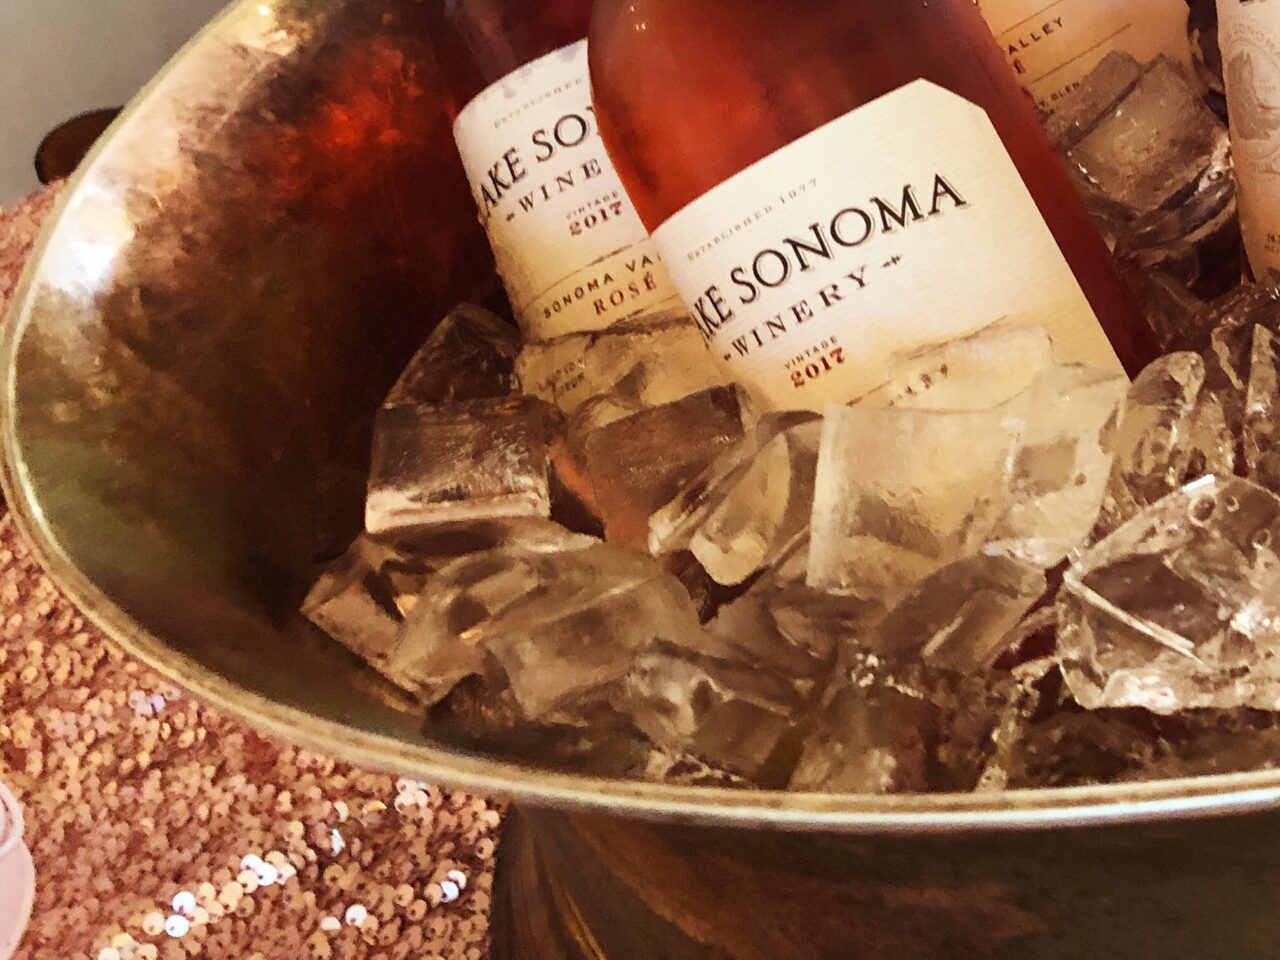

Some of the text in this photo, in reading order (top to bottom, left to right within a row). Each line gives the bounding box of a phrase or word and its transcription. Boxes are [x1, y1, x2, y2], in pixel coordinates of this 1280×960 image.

[1008, 16, 1062, 55] ALLEY
[479, 147, 526, 218] AKE
[518, 158, 602, 214] WINE
[569, 200, 622, 236] 2017
[691, 172, 967, 350] AKE SONOMA
[543, 272, 614, 319] SONOMA
[731, 264, 868, 357] WINERY
[785, 335, 838, 370] VINTAGE
[791, 347, 844, 388] 2017
